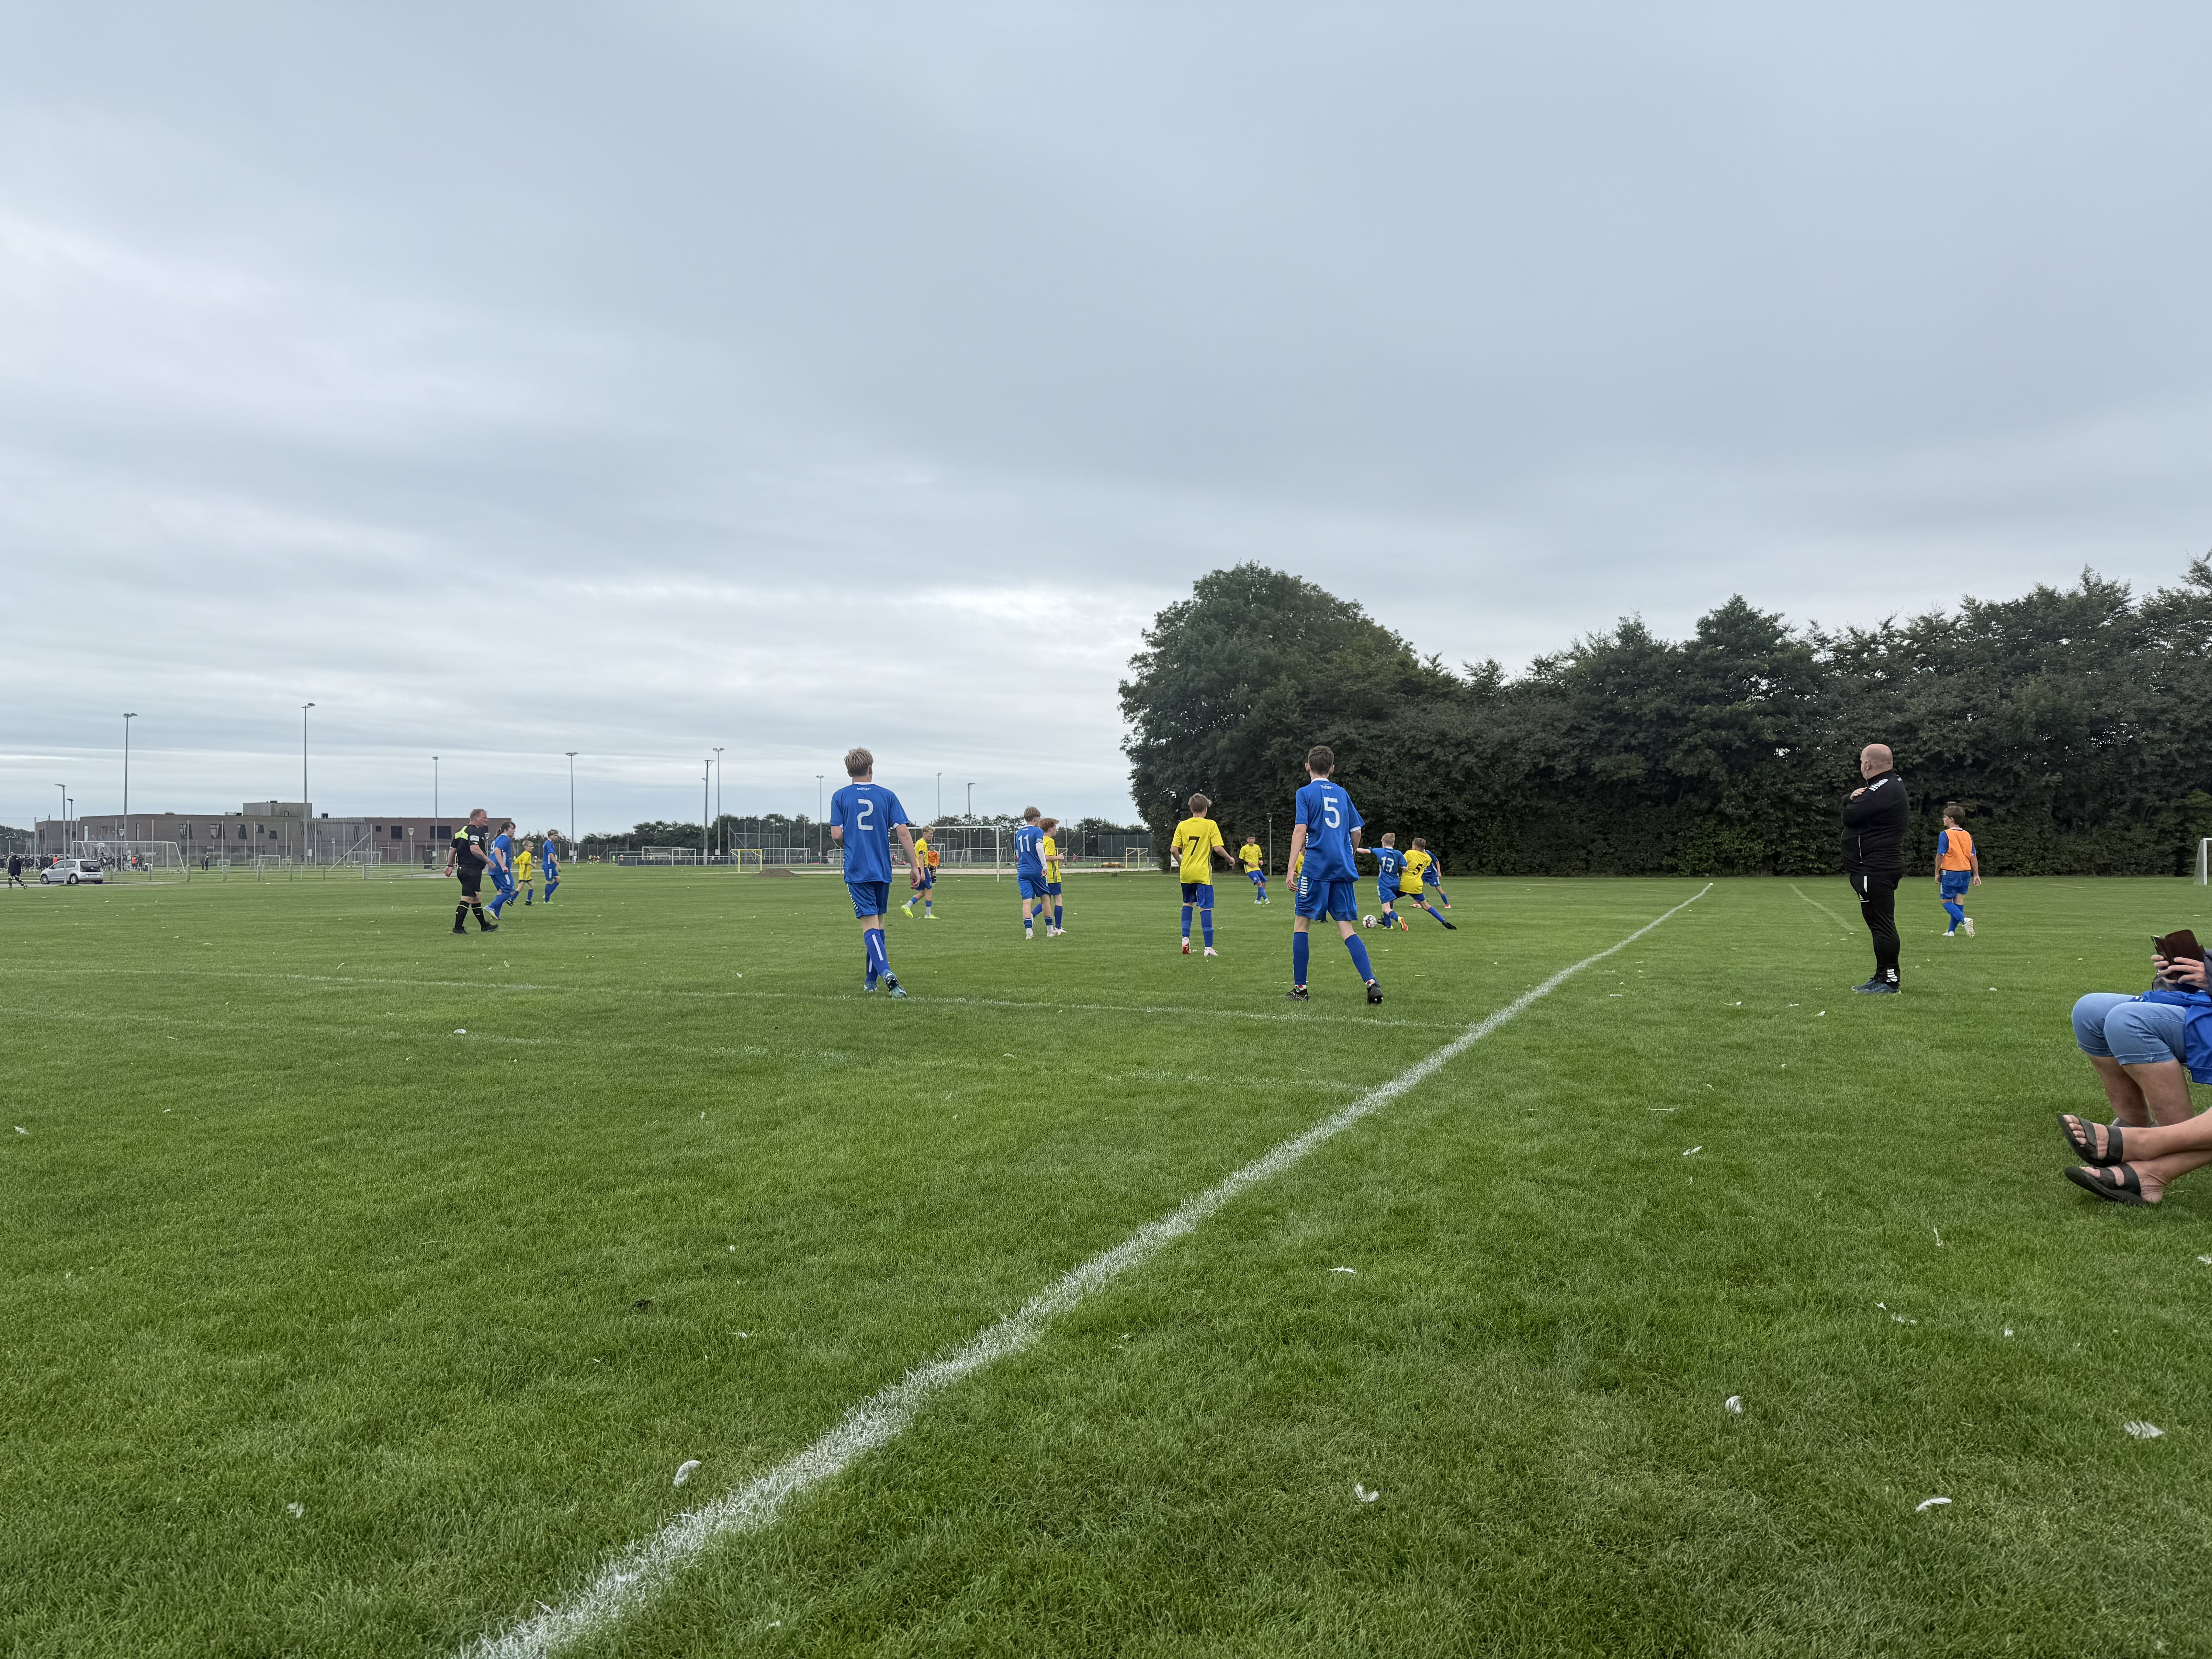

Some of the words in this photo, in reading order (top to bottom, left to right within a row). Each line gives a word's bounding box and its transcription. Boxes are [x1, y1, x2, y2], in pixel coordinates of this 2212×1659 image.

[857, 799, 874, 830] 2
[1323, 797, 1340, 829] 5
[1018, 834, 1030, 852] 11
[1188, 836, 1200, 856] 7
[1381, 856, 1394, 873] 13
[1412, 863, 1424, 876] 5
